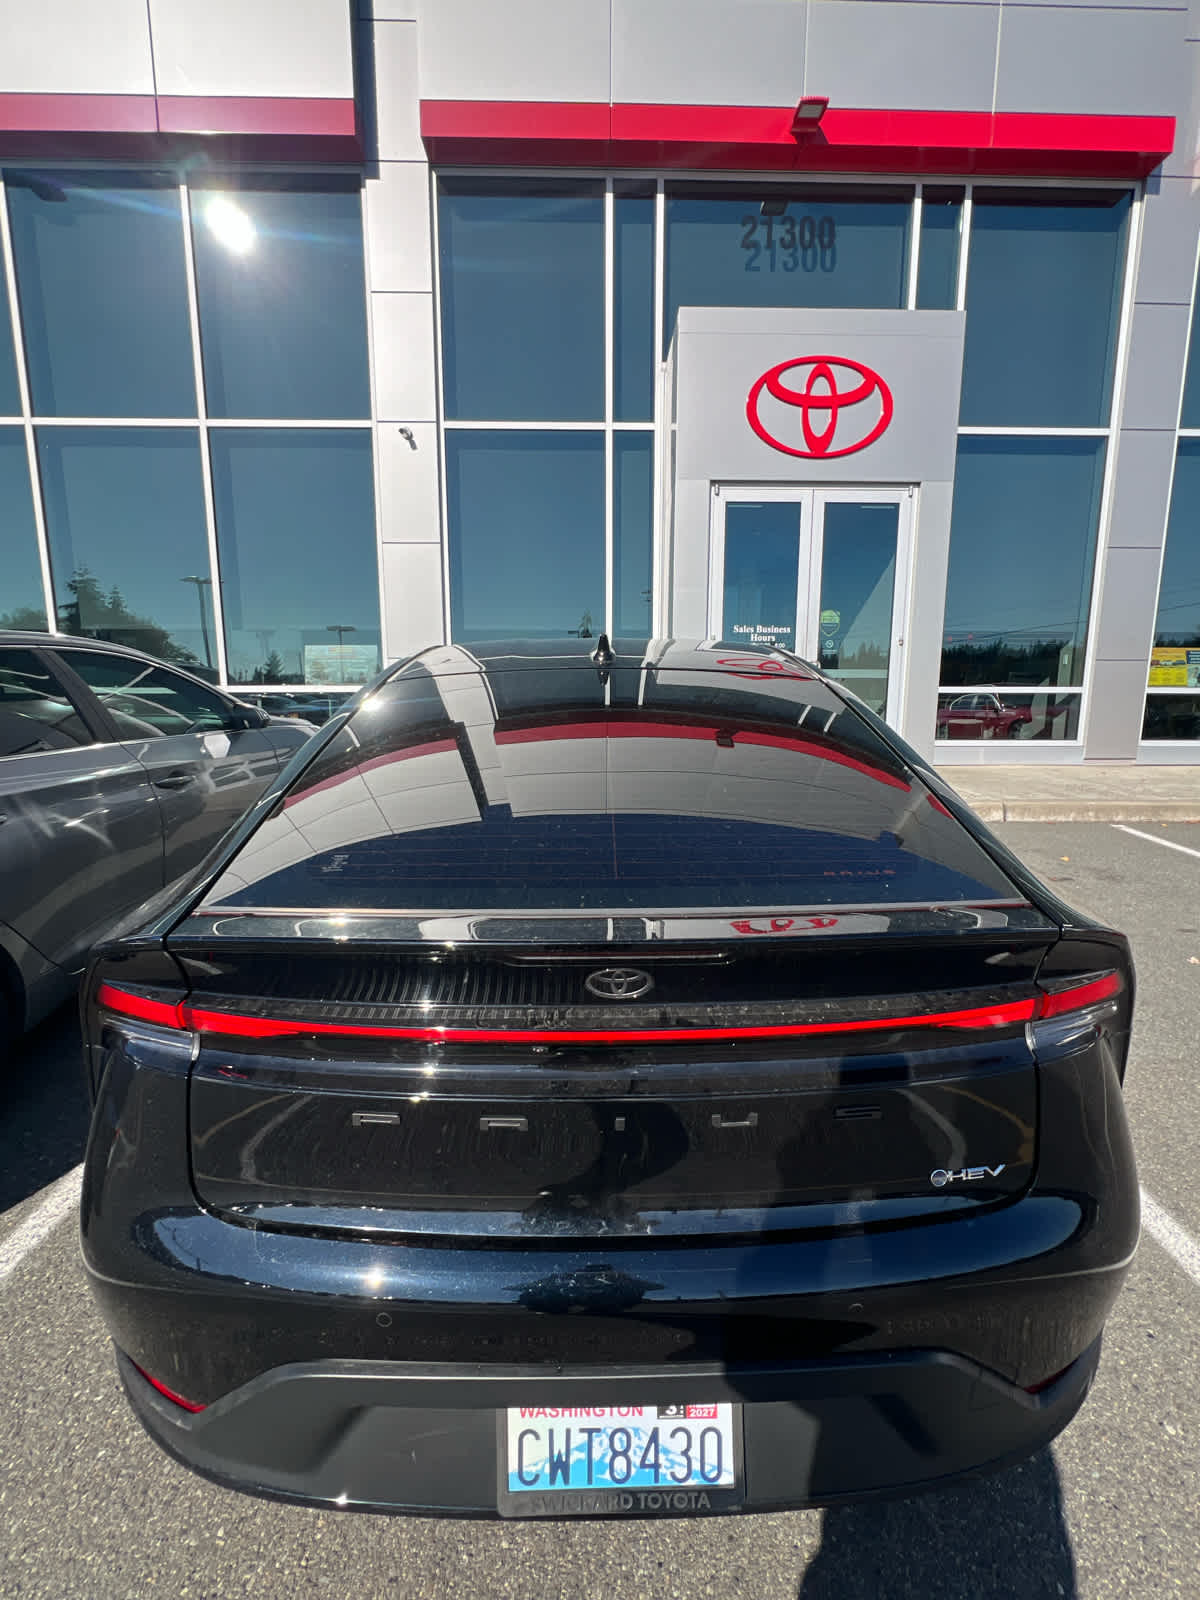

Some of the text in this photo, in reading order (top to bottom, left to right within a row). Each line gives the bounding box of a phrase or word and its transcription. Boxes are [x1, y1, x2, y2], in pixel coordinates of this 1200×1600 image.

[740, 215, 837, 249] 21300
[733, 624, 791, 634] Sales Business
[750, 634, 776, 642] Hours
[519, 1405, 643, 1418] WASHINGTON
[689, 1408, 715, 1417] 2027
[517, 1426, 723, 1487] CWT8430
[639, 1491, 711, 1511] TOYOTA
